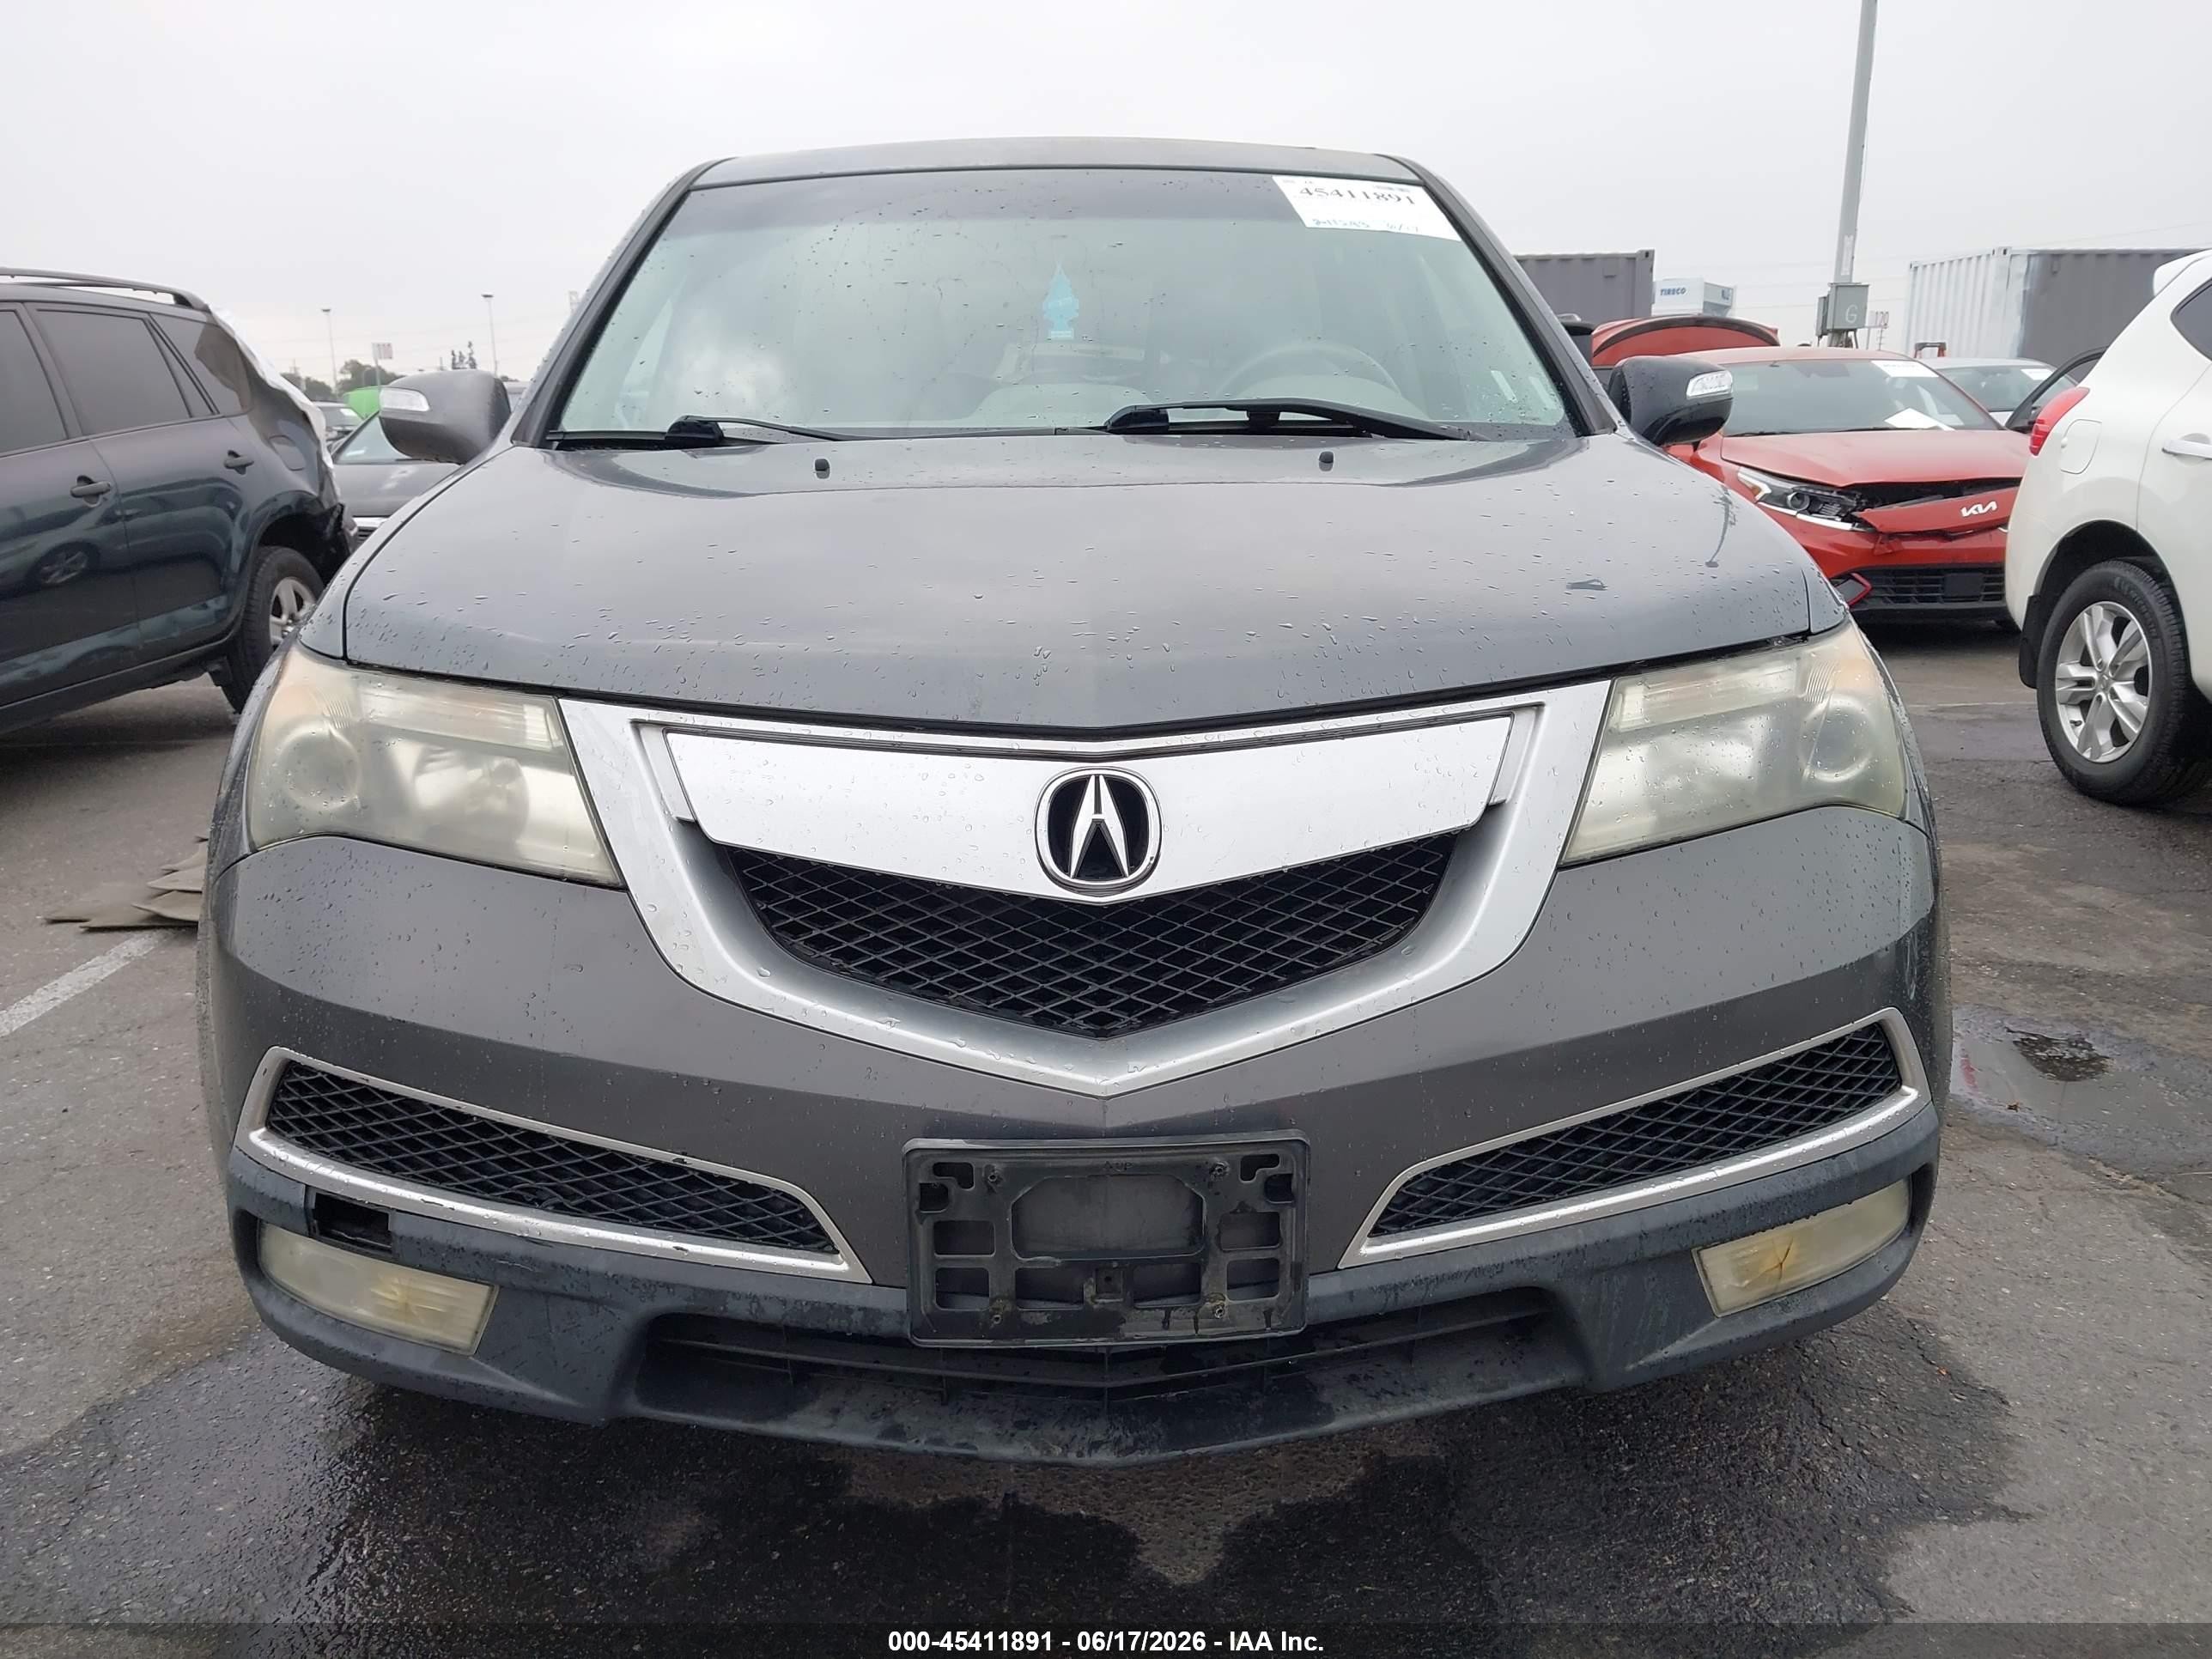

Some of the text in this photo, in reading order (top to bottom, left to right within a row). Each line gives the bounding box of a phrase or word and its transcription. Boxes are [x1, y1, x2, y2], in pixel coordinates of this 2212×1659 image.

[1299, 186, 1415, 205] 45411891
[1845, 304, 1857, 324] G
[1960, 501, 1997, 517] KIA
